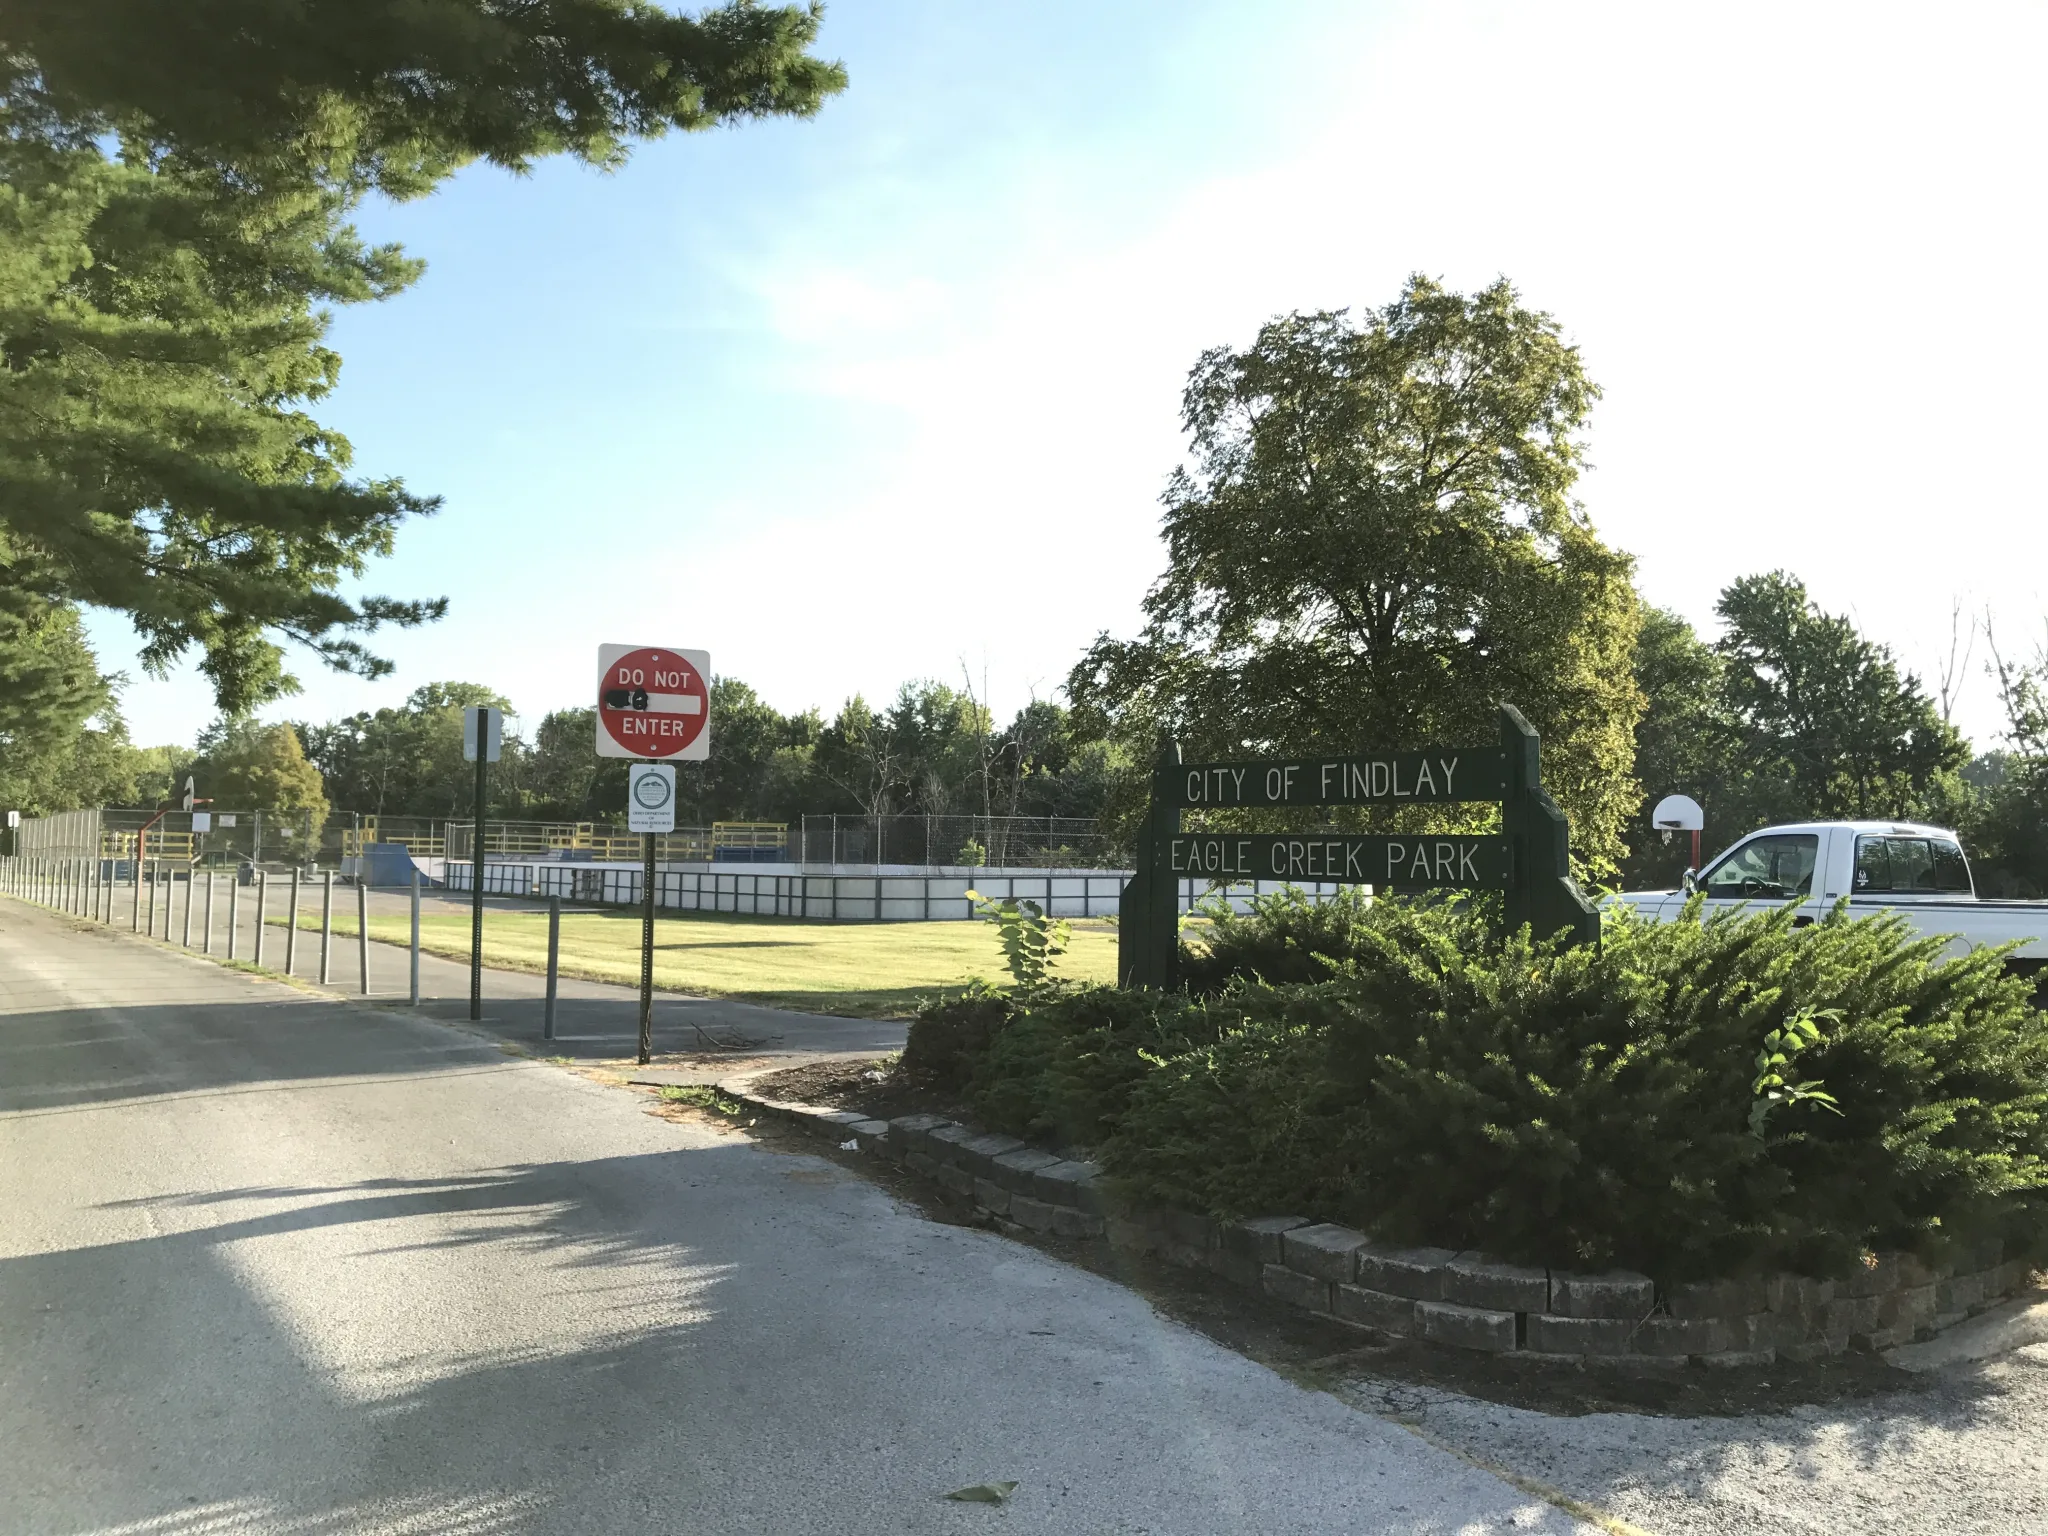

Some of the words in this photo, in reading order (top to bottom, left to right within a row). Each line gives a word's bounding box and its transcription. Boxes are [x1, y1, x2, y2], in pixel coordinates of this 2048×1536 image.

[619, 668, 644, 685] DO
[654, 671, 691, 688] NOT
[623, 717, 684, 736] ENTER
[1187, 768, 1246, 801] CITY
[1266, 765, 1300, 800] OF
[1321, 757, 1458, 799] FINDLAY
[1171, 840, 1252, 873] EAGLE
[1271, 841, 1363, 878] CREEK
[1386, 842, 1479, 882] PARK
